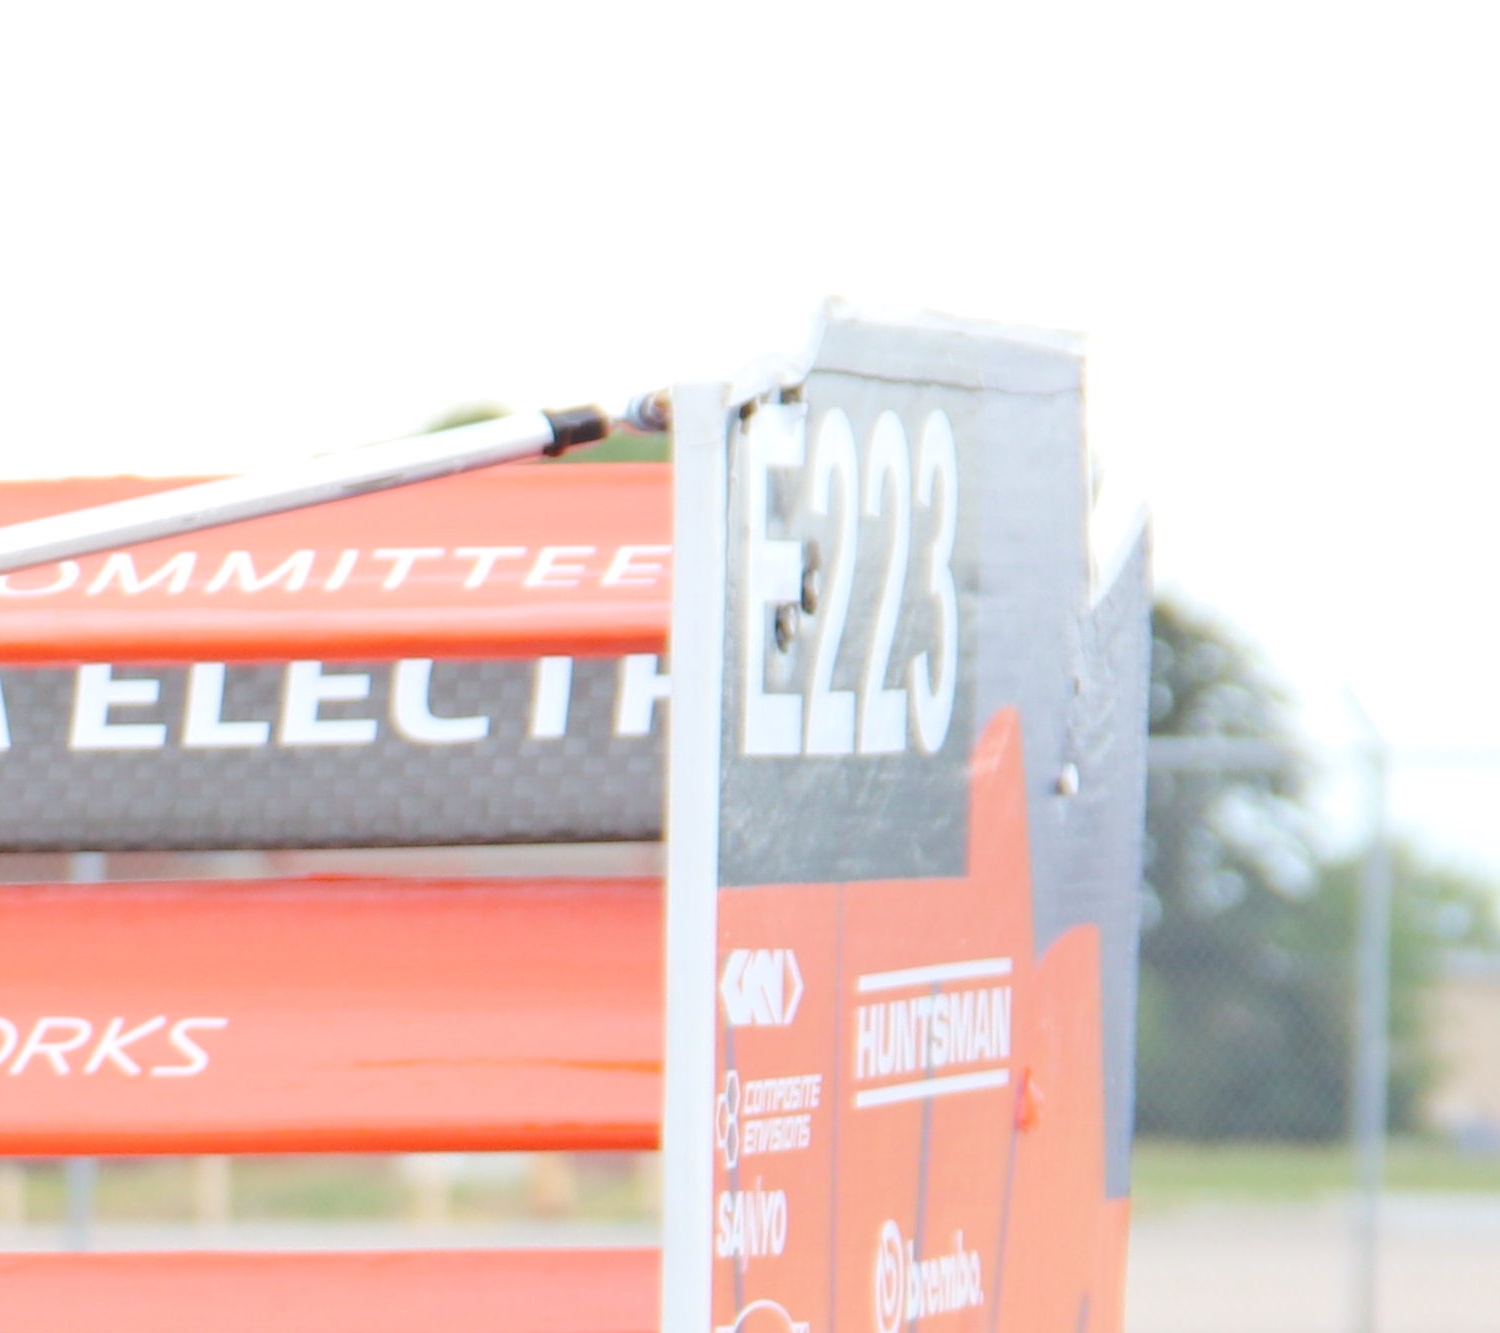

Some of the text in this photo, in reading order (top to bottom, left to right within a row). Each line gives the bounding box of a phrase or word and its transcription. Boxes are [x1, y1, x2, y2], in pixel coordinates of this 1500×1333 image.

[743, 401, 959, 756] E223
[855, 986, 1012, 1080] HUNTSMAN
[715, 1182, 787, 1262] SANYO
